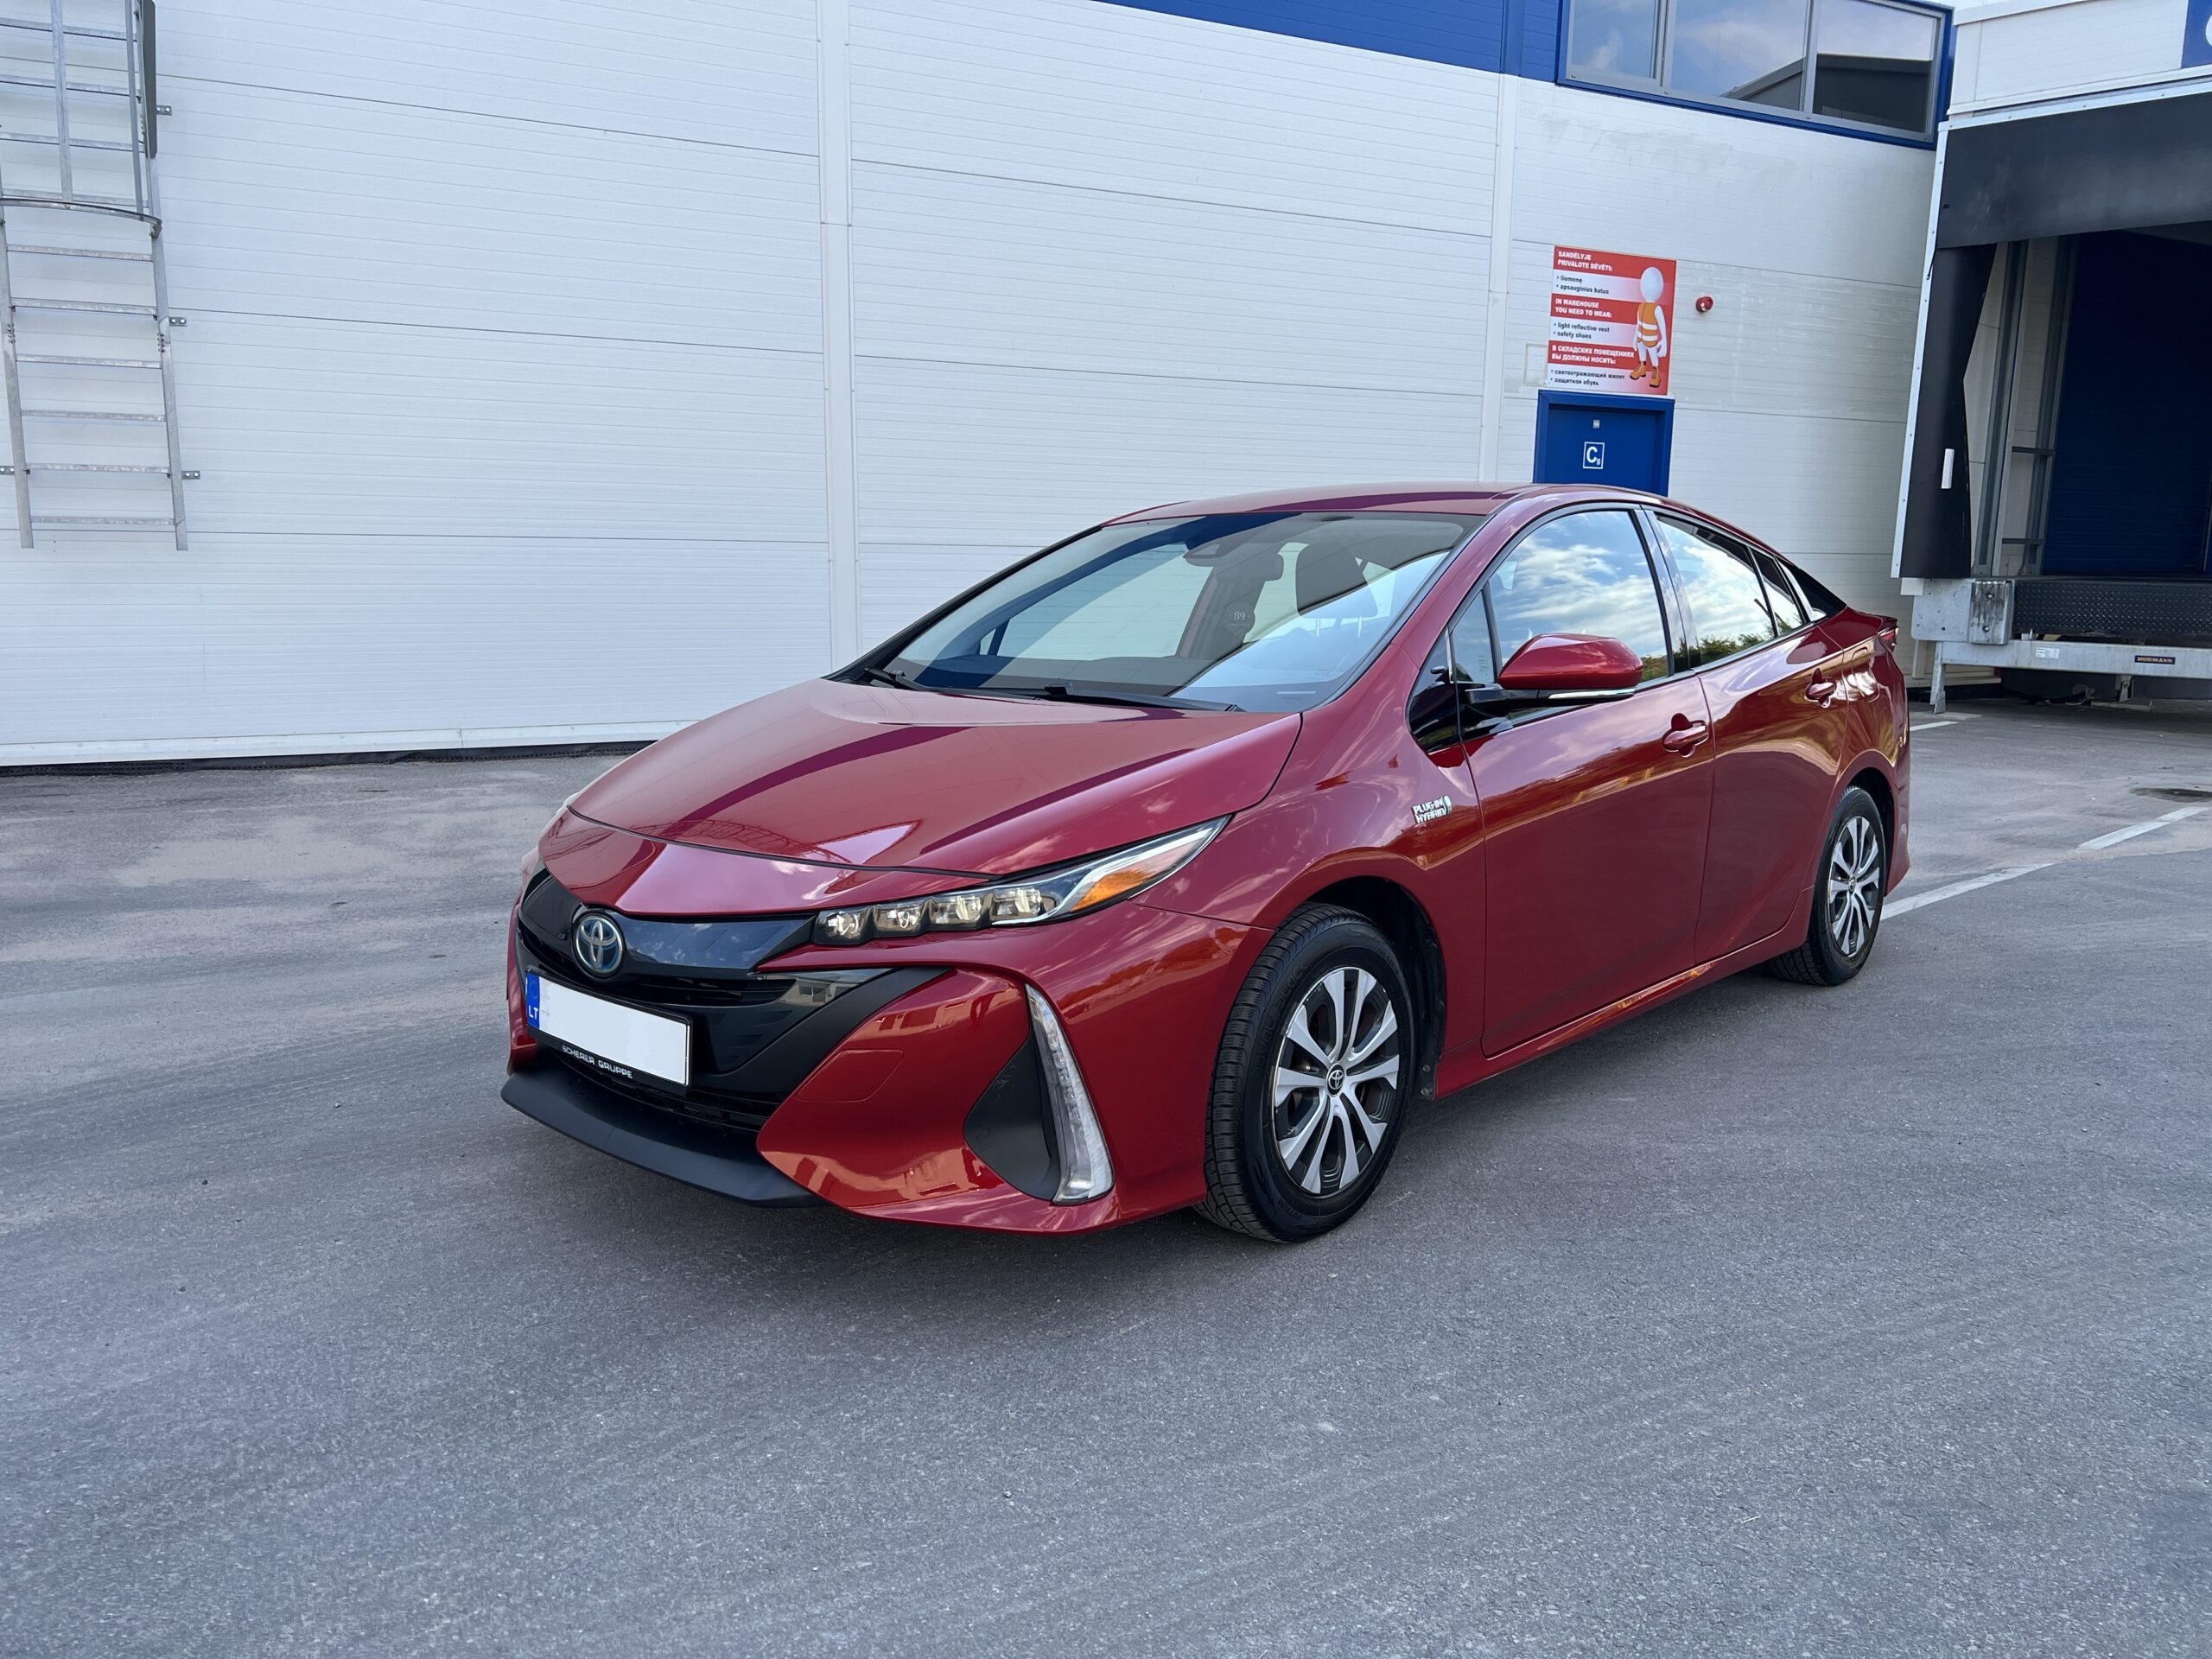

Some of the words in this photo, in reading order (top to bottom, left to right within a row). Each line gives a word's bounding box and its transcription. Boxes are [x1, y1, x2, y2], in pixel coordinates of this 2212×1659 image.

[1557, 259, 1590, 269] PRIVALOTE
[1560, 284, 1593, 293] apsauginius
[1563, 299, 1599, 308] WAREHOUSE
[1571, 323, 1598, 332] reflective
[1557, 346, 1592, 355] СКЛАДСКИХ
[1593, 349, 1635, 359] ПОМЕЩЕНИЯХ
[1562, 353, 1591, 362] ДОЛЖНЫ
[528, 1004, 539, 1020] LT
[562, 1045, 595, 1065] SCHERER
[597, 1059, 633, 1079] GRUPPE
